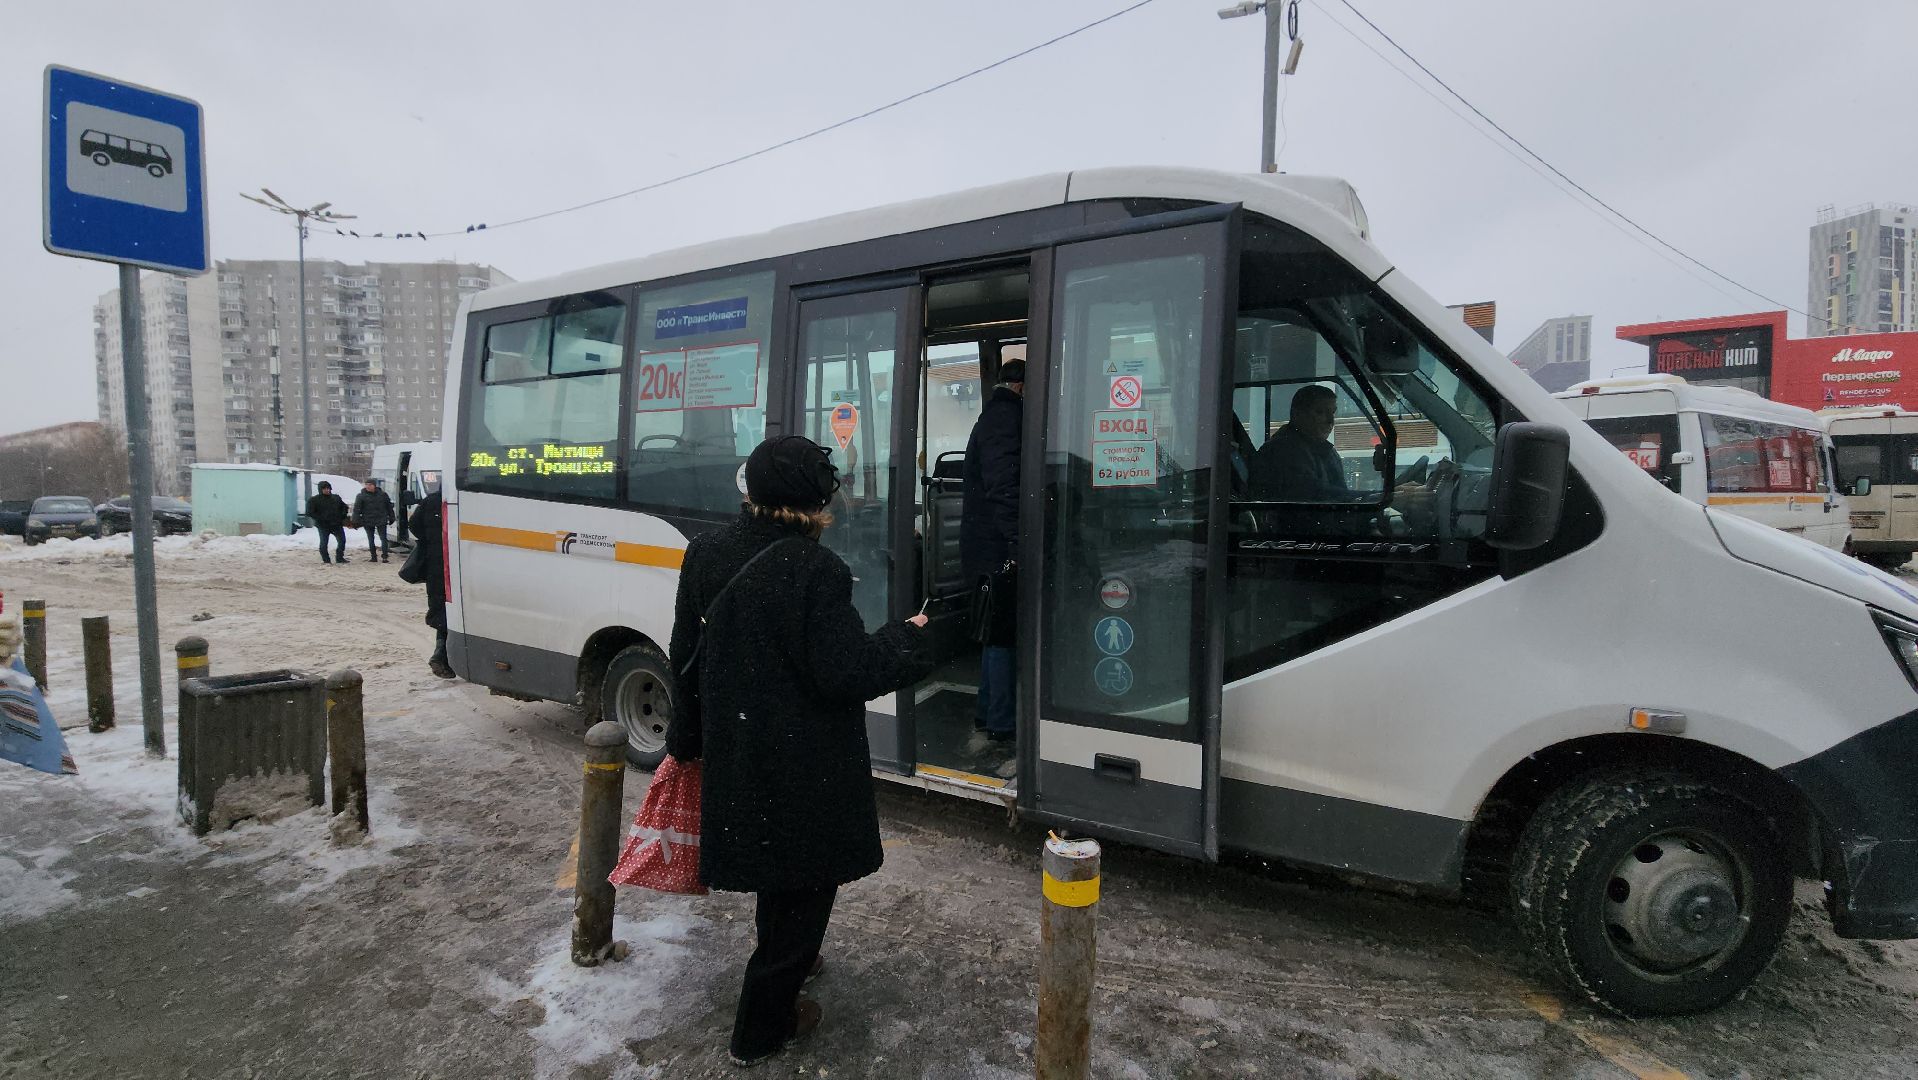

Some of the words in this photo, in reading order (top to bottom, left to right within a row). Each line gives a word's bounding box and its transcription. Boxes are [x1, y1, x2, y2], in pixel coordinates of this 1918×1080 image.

[656, 317, 677, 329] ООО
[677, 309, 746, 327] «ТрансИнвест»
[1839, 387, 1892, 396] RENDEZ-VOUS
[1099, 418, 1149, 435] ВХОД
[508, 447, 534, 459] ст.
[543, 443, 604, 459] Мытищи
[499, 462, 525, 476] ул.
[535, 458, 615, 475] Троицкая
[1098, 469, 1113, 479] 62
[1115, 467, 1150, 480] рубля
